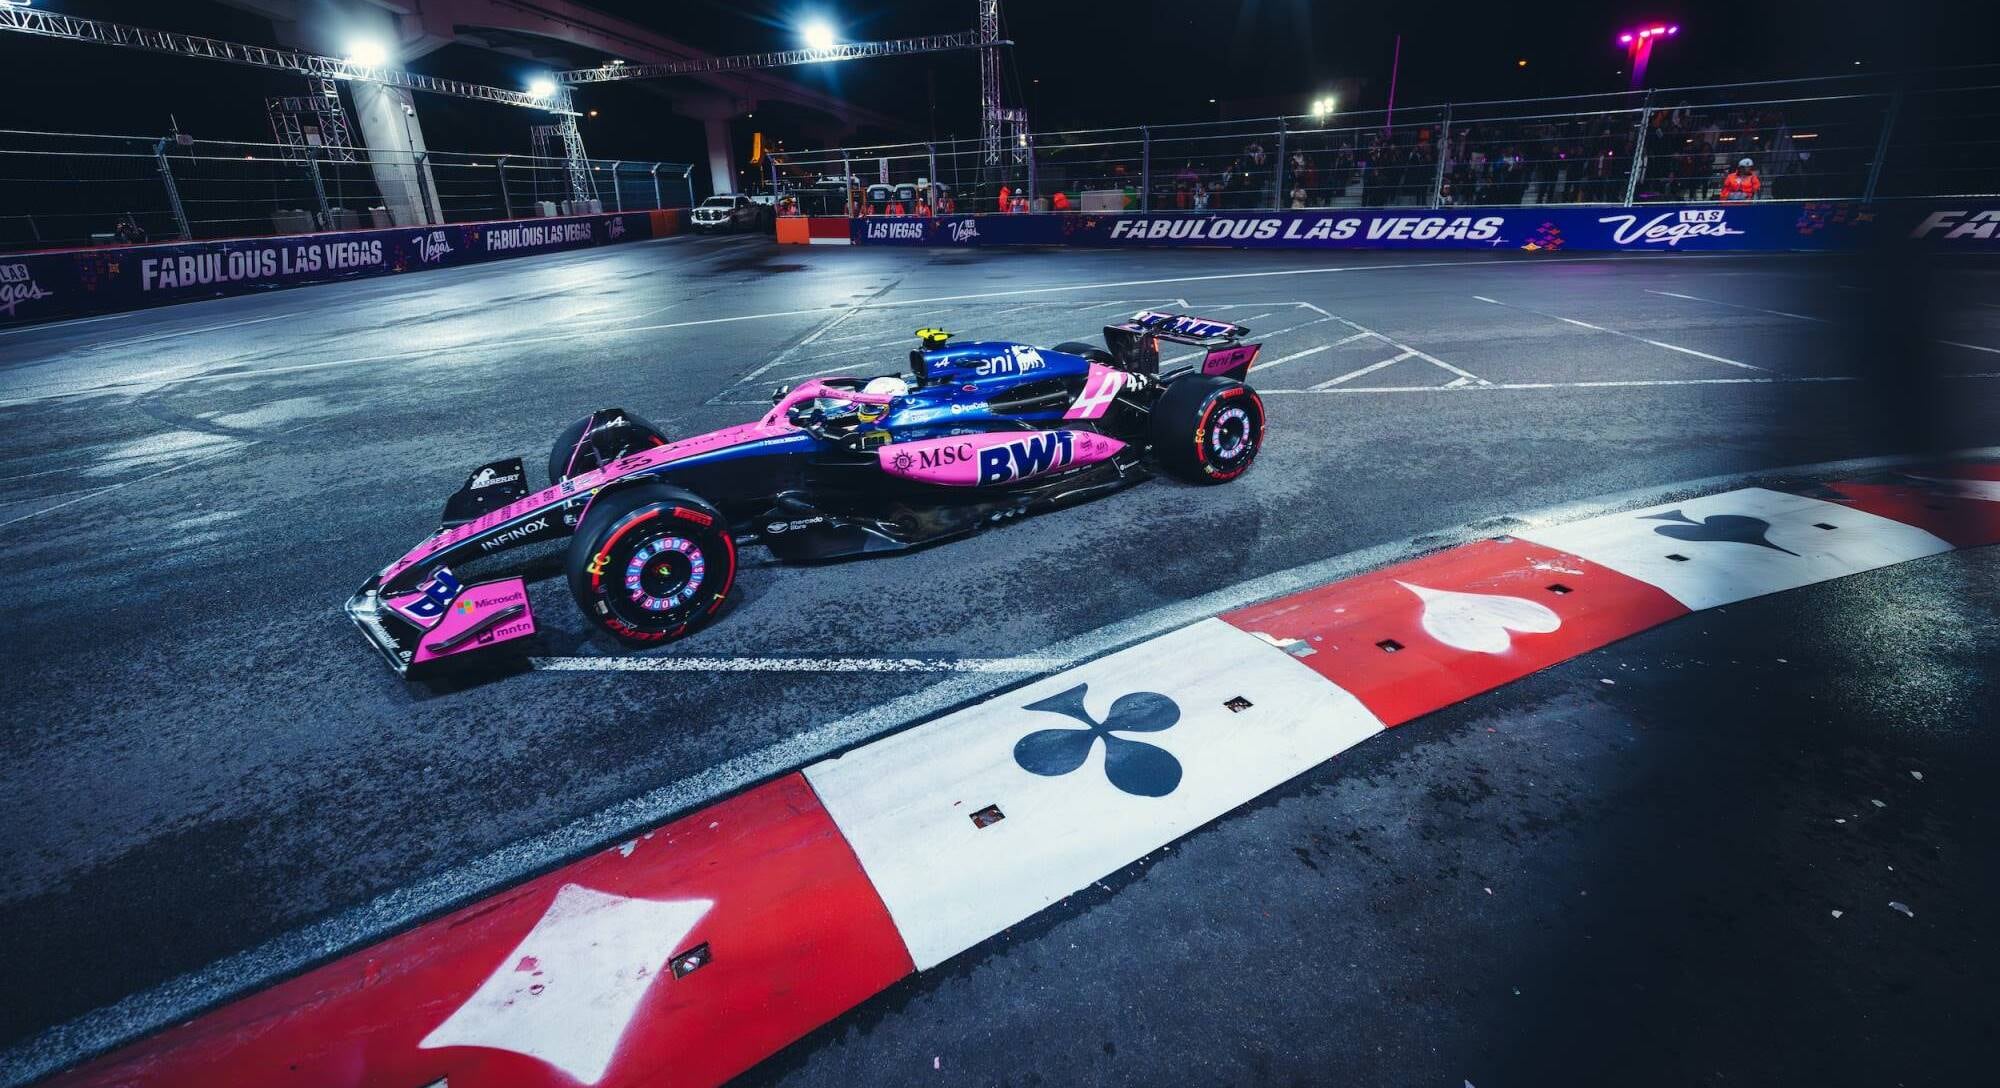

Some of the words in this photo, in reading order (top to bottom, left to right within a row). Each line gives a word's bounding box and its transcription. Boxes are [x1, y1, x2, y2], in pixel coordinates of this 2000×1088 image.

[1110, 218, 1282, 239] FABULOUS
[1283, 217, 1357, 240] LAS
[1366, 216, 1503, 241] VEGAS
[1599, 212, 1745, 246] Vegas
[1683, 211, 1720, 221] LAS
[1908, 211, 2000, 239] FA
[487, 225, 543, 251] FABULOUS
[544, 223, 563, 243] LAS
[563, 222, 592, 242] VEGAS
[867, 223, 887, 239] LAS
[889, 222, 923, 239] VEGAS
[948, 221, 981, 243] Vegas
[412, 231, 453, 263] Vegas
[142, 248, 276, 291] FABULOUS
[282, 244, 322, 275] LAS
[325, 239, 383, 270] VEGAS
[976, 349, 1013, 376] eni
[1208, 354, 1232, 368] eni
[919, 442, 973, 470] MSC
[976, 430, 1077, 487] BWT
[481, 517, 550, 551] INFINOX
[790, 516, 824, 526] mercado
[475, 591, 523, 610] Microsoft
[496, 622, 531, 638] mntn
